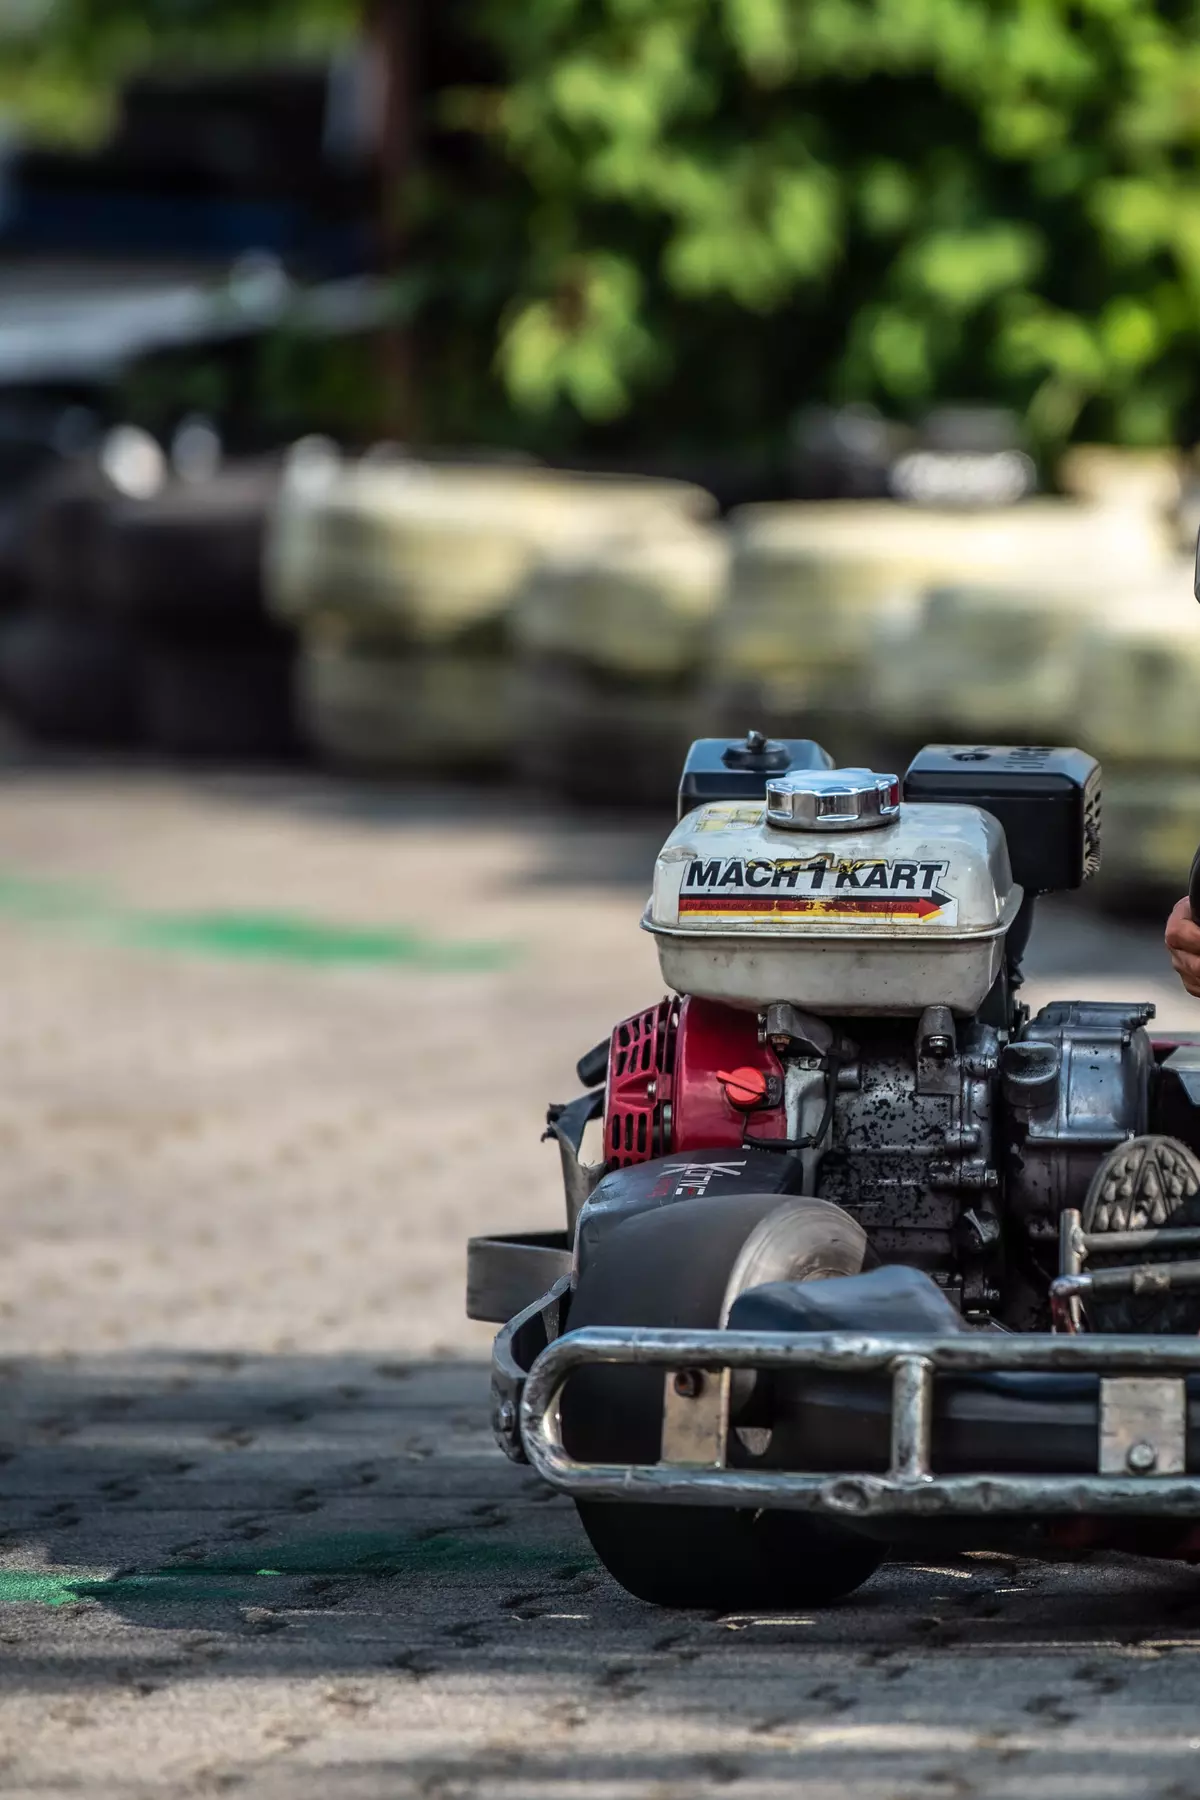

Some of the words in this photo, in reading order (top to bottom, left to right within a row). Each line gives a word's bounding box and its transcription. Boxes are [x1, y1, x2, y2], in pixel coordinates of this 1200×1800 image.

[686, 861, 800, 888] MACH
[808, 855, 831, 889] 1
[835, 861, 943, 890] KART
